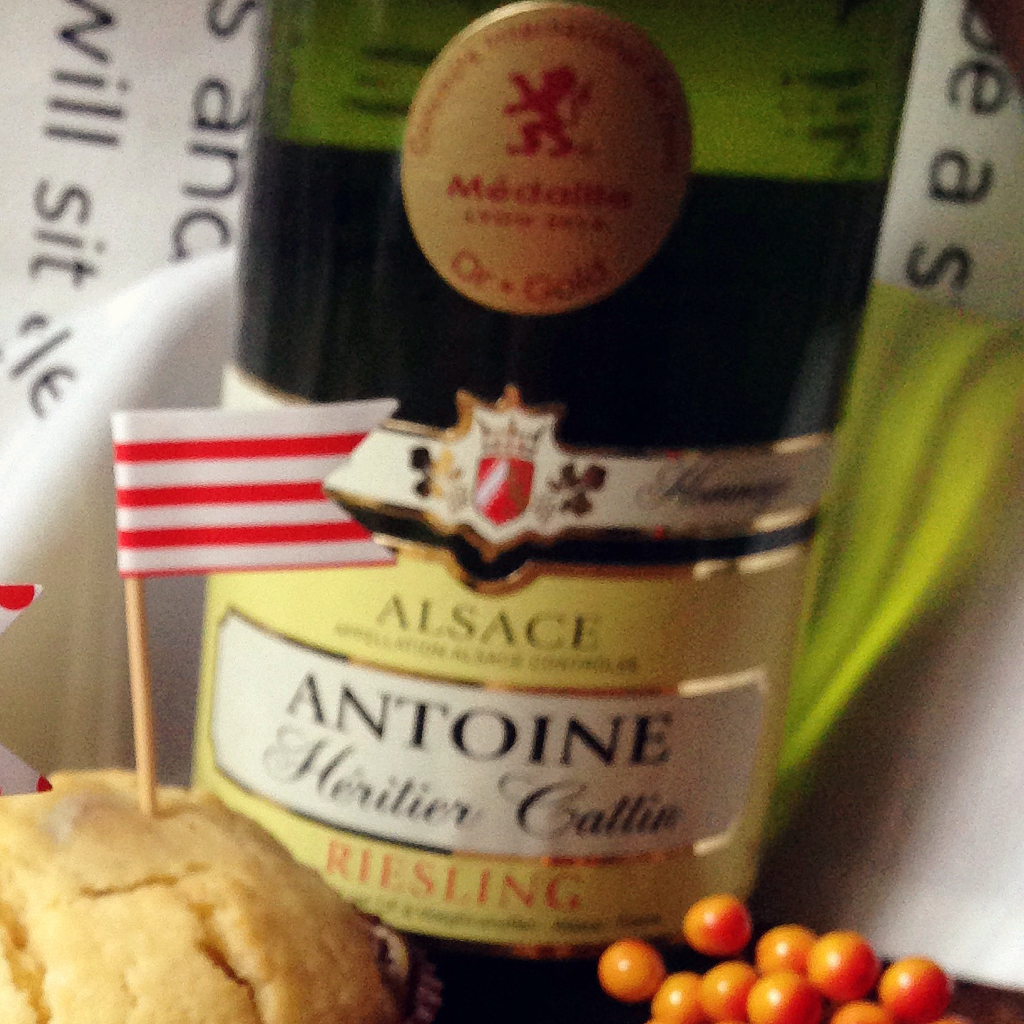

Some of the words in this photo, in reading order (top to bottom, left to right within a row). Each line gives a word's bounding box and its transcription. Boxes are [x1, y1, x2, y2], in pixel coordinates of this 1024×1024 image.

[26, 177, 110, 288] sit
[377, 595, 602, 652] ALSACE
[286, 672, 676, 768] ANTOINE
[325, 839, 583, 911] RIESLING
